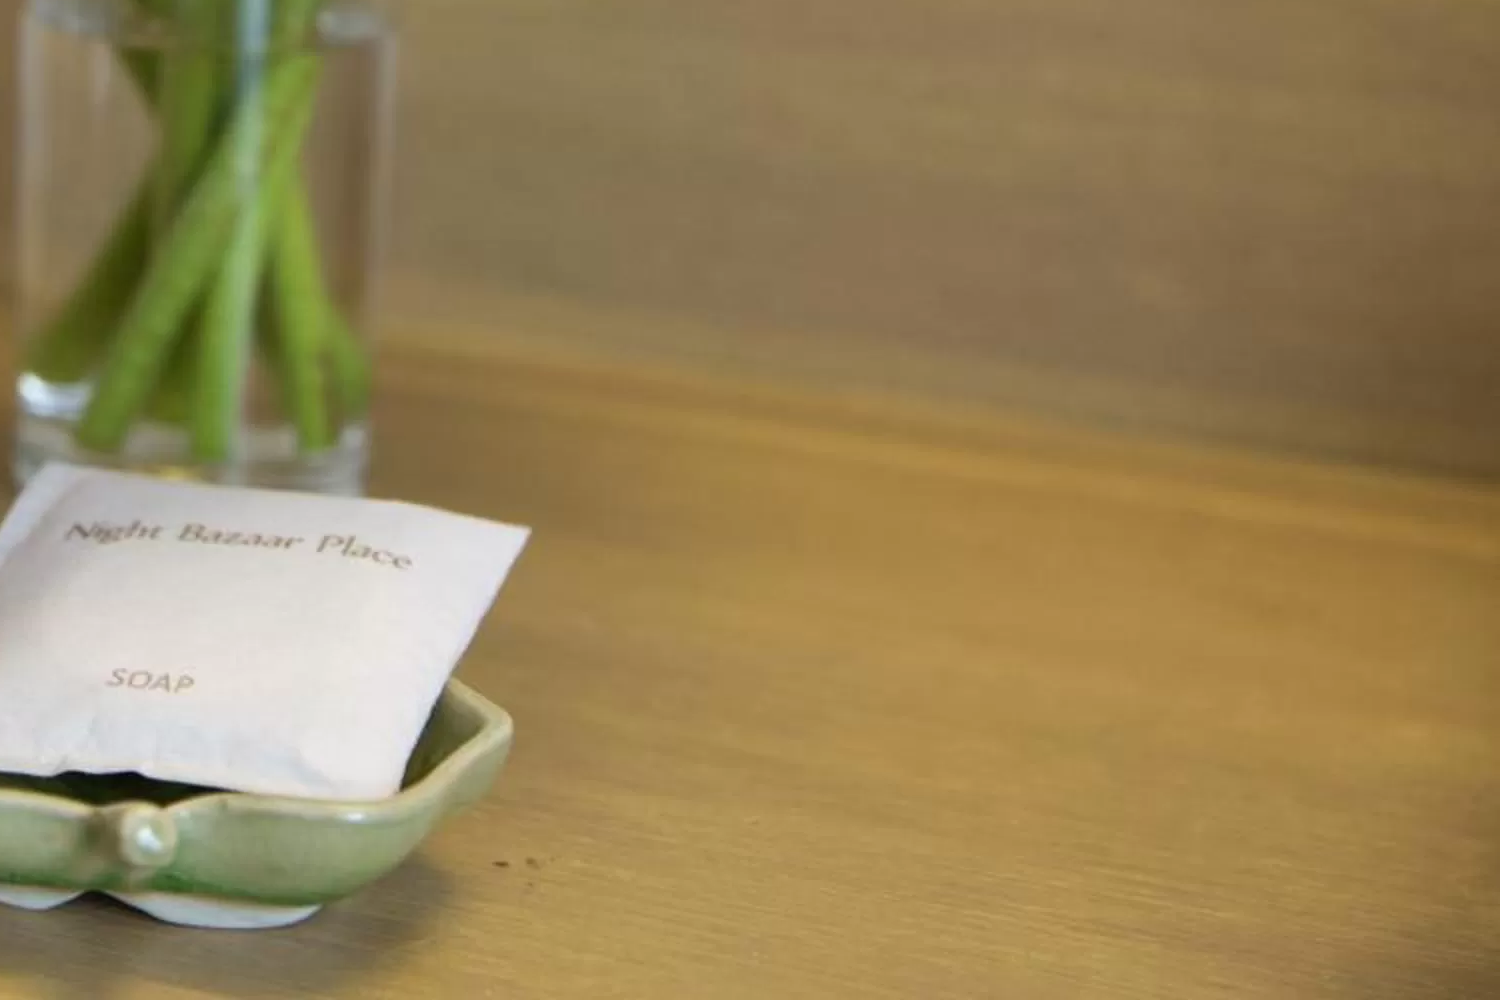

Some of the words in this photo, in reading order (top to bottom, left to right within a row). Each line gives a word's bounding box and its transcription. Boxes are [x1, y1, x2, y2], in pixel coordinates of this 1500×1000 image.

[63, 518, 165, 545] Night
[176, 522, 305, 550] Bazaar
[315, 533, 414, 570] Place
[105, 666, 196, 695] SOAP
